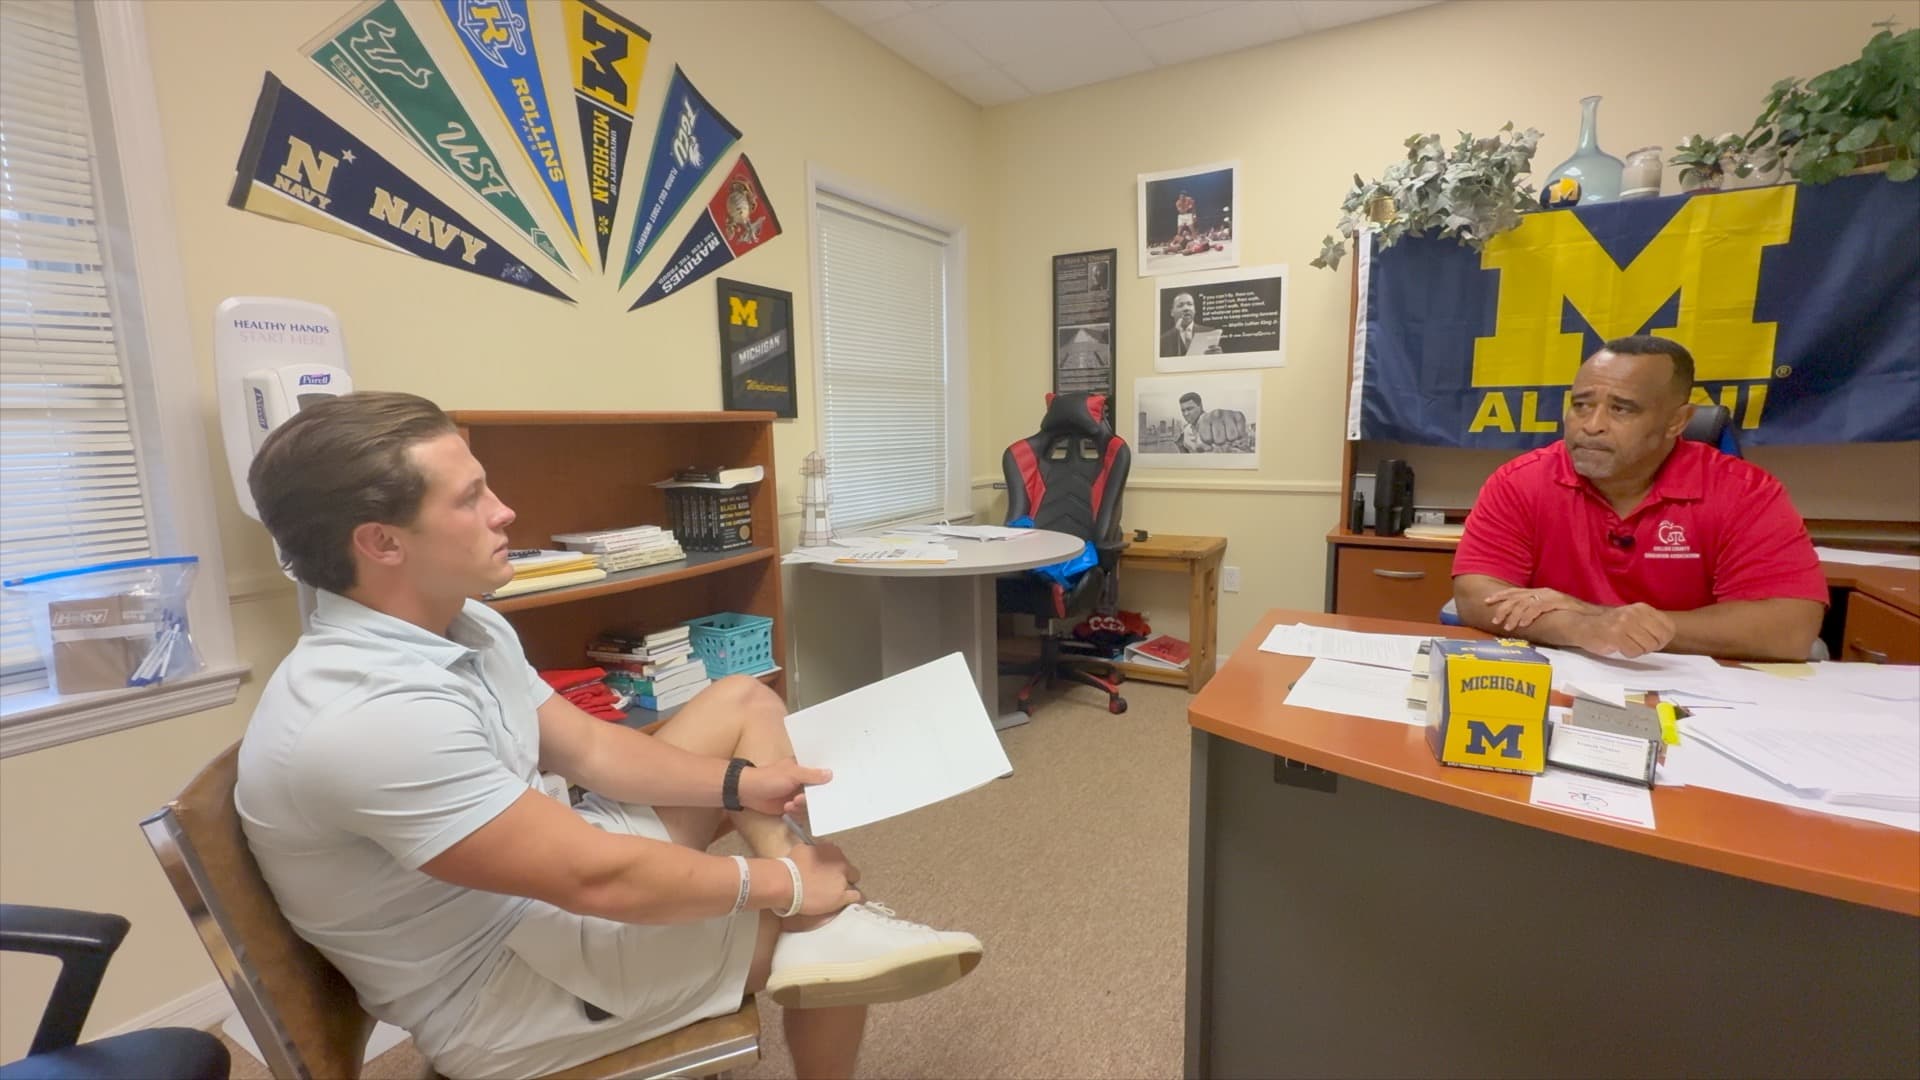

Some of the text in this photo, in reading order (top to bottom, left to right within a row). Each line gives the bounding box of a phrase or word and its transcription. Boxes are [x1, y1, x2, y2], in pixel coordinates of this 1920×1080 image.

[582, 10, 628, 107] M
[511, 77, 564, 182] ROLLINS
[593, 110, 609, 204] MICHIGAN
[273, 174, 332, 210] NAVY
[279, 135, 340, 195] N
[369, 187, 487, 265] NAVY
[661, 236, 720, 293] MARINES
[1471, 184, 1796, 388] M
[234, 319, 330, 334] HEALTHY HANDS
[729, 296, 759, 328] M
[739, 335, 781, 365] MICHIGAN
[1461, 674, 1537, 699] MICHIGAN
[1466, 720, 1525, 759] M
